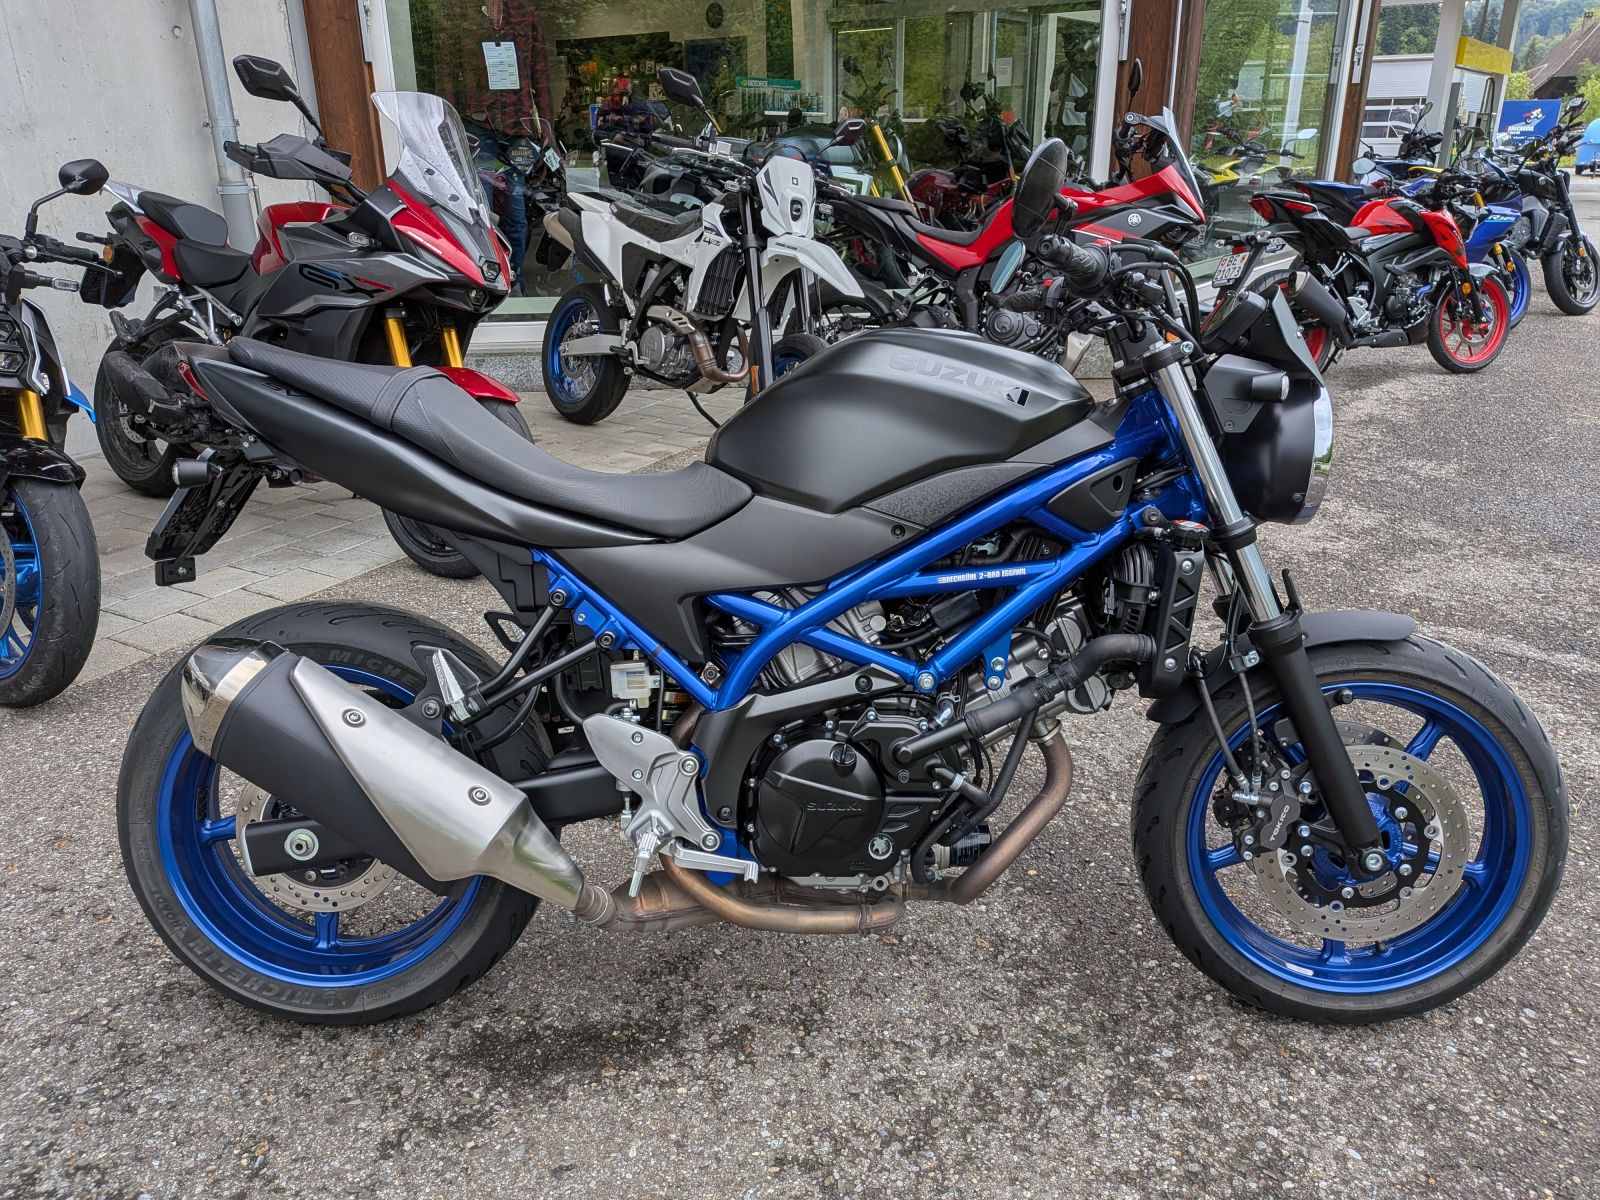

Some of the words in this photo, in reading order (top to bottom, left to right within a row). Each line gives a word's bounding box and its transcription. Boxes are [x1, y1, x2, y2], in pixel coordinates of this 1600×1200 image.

[1215, 266, 1242, 280] 21073
[1227, 256, 1239, 267] BE
[889, 349, 1030, 407] SUZUKI
[979, 569, 1001, 580] 2-RAD
[327, 649, 423, 688] MICHE
[806, 802, 862, 811] SUZUKI
[1269, 804, 1290, 842] TOKICO
[185, 935, 315, 1005] MICHELIN
